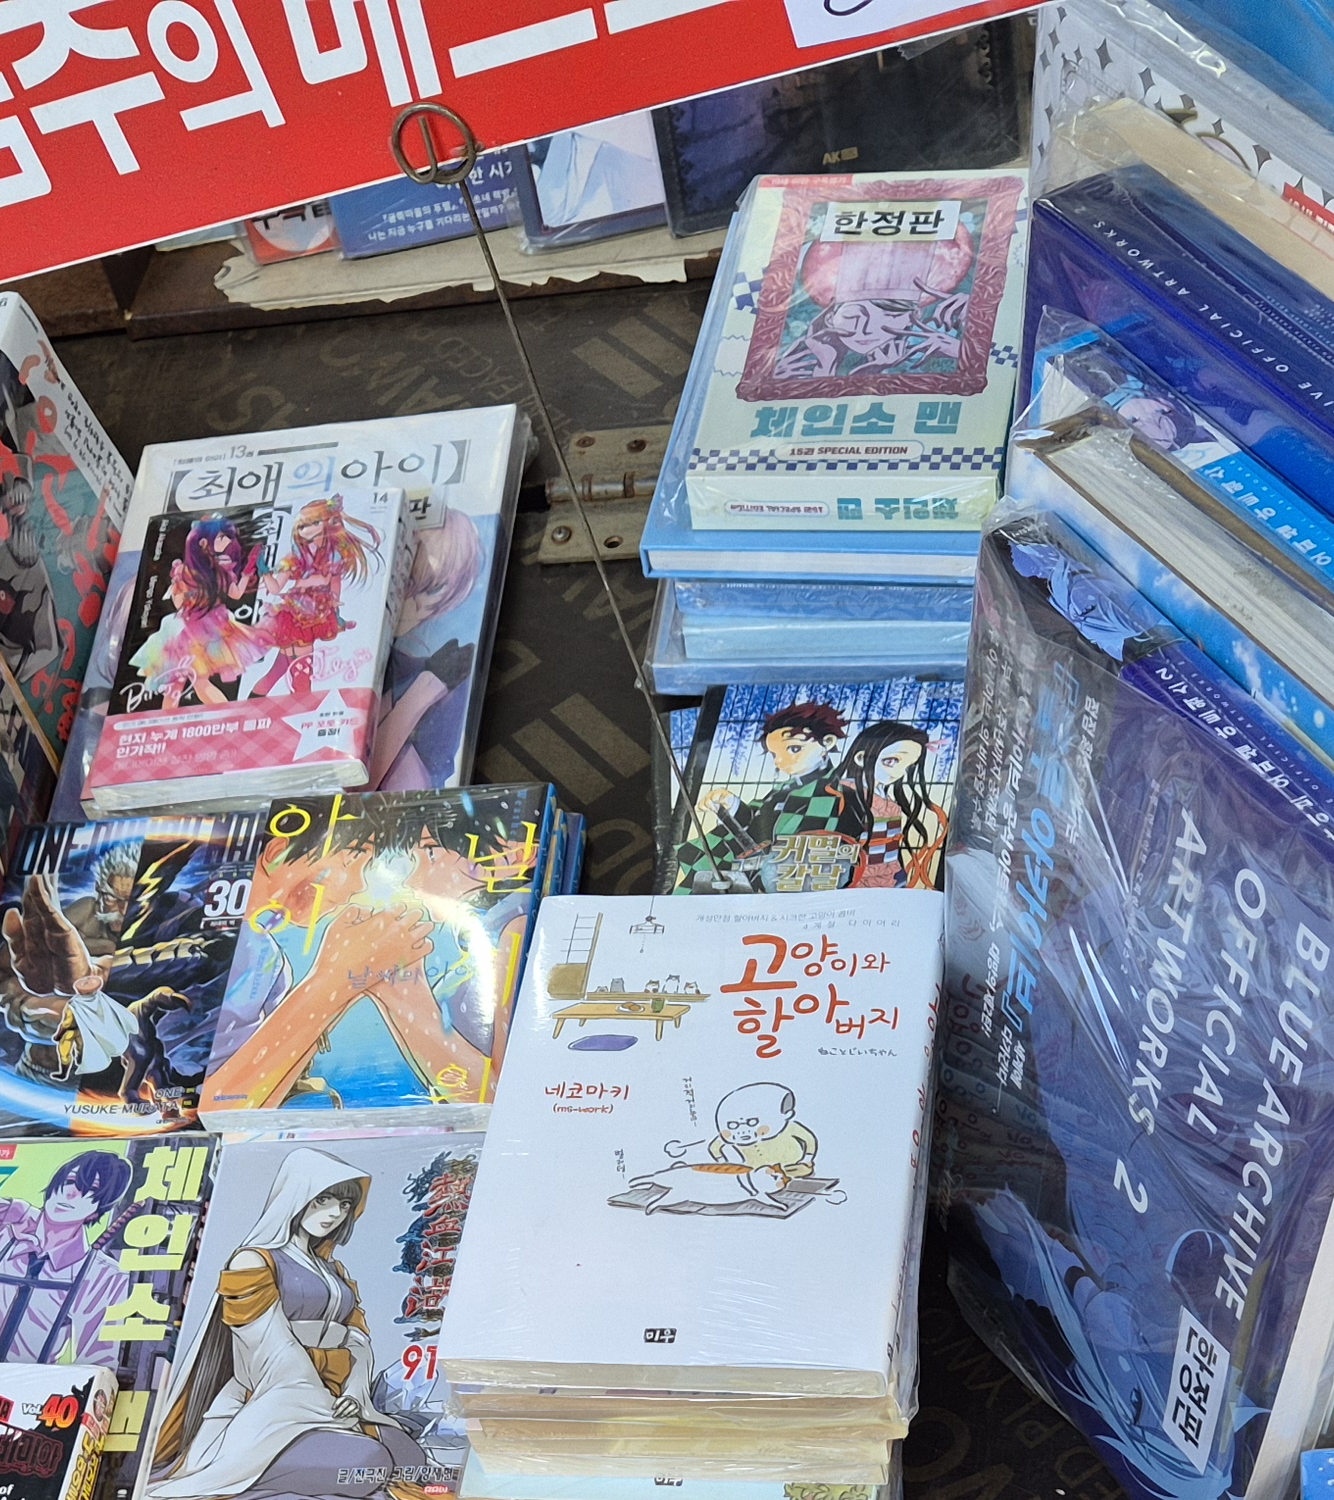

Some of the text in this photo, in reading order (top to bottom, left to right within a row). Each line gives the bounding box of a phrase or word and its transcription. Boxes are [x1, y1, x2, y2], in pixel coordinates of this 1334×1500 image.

[832, 210, 945, 237] 한정판
[1093, 220, 1190, 297] ARTWORKS
[1199, 302, 1290, 373] OFFICIAL
[750, 401, 961, 440] 체인소 맨
[340, 438, 471, 488] 아이】
[817, 445, 861, 457] SPECIAL
[864, 444, 909, 455] EDITION
[372, 492, 388, 504] 14
[116, 741, 165, 759] 인기작!!
[181, 723, 241, 739] 1800만부
[204, 879, 248, 917] 30
[720, 932, 890, 994] 고양이와
[1129, 807, 1208, 1136] ARTWORKS
[733, 982, 899, 1059] 할아버지
[1188, 867, 1267, 1136] OFFICIAL
[63, 1100, 178, 1114] YUSUKE MURATA
[544, 1082, 630, 1100] 네코마키
[1215, 921, 1329, 1322] BLUE ARCHIVE
[101, 1147, 208, 1342] 체인소
[644, 1328, 677, 1345] 미우
[401, 1346, 436, 1381] 91
[1177, 1330, 1218, 1444] 한정판
[337, 1468, 388, 1485] 글/전극진
